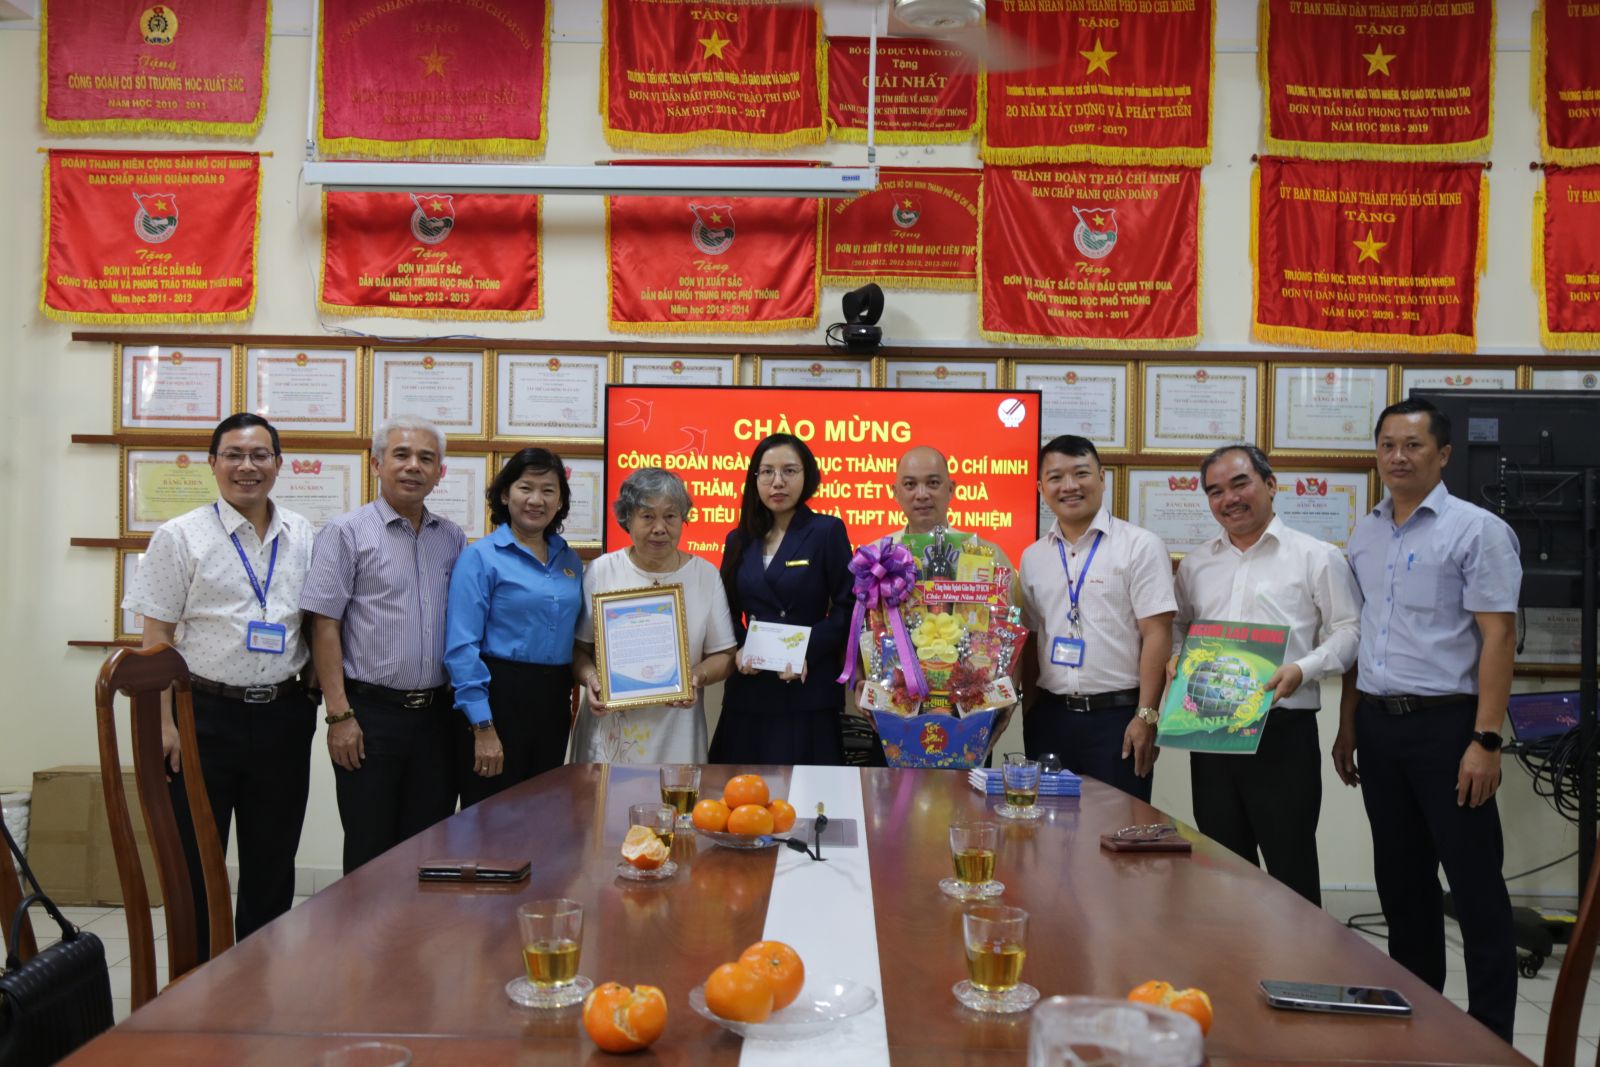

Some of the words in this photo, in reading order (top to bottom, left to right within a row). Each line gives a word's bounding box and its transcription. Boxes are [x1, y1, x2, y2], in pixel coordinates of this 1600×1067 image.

[1079, 17, 1120, 29] TẶNG
[1355, 21, 1406, 37] TẶNG
[893, 59, 918, 69] Tặng
[68, 74, 91, 89] CÔNG
[95, 72, 119, 89] ĐOÀN
[121, 74, 132, 89] CƠ
[135, 70, 148, 90] SỞ
[149, 73, 182, 90] TRƯỜNG
[185, 77, 202, 94] HỌC
[204, 73, 225, 92] XUẤT
[228, 71, 244, 92] SẮC
[902, 72, 948, 88] NHẤT
[1006, 105, 1018, 117] 20
[1021, 102, 1047, 117] NĂM
[1050, 102, 1071, 116] XÂY
[1076, 103, 1105, 118] DỰNG
[1108, 102, 1124, 118] VÀ
[1126, 104, 1155, 119] PHÁT
[1157, 98, 1192, 117] TRIỂN
[1290, 104, 1308, 114] ĐƠN
[1312, 105, 1321, 117] VỊ
[1324, 102, 1342, 115] DẪN
[1345, 103, 1364, 116] ĐẦU
[1368, 106, 1400, 117] PHONG
[1403, 104, 1429, 118] TRÀO
[1431, 107, 1447, 117] THI
[1450, 105, 1471, 115] ĐUA
[1331, 120, 1353, 131] NĂM
[1356, 122, 1377, 133] HỌC
[1380, 123, 1400, 132] 2018
[1408, 123, 1428, 132] 2019
[61, 158, 86, 169] ĐOÀN
[89, 160, 120, 169] THANH
[123, 158, 144, 169] NIÊN
[147, 157, 171, 171] CỘNG
[175, 157, 193, 169] SẢN
[196, 157, 208, 169] HỒ
[212, 158, 226, 169] CHÍ
[229, 159, 252, 169] MINH
[89, 175, 107, 184] BAN
[109, 173, 133, 184] CHẤP
[136, 173, 162, 184] HÀNH
[165, 174, 189, 187] QUẬN
[192, 173, 216, 184] ĐOÀN
[219, 175, 224, 184] 9
[1012, 169, 1051, 182] THÀNH
[1055, 171, 1086, 184] ĐOÀN
[1127, 171, 1148, 184] CHÍ
[1151, 174, 1180, 184] MINH
[1033, 187, 1049, 197] BAN
[1052, 184, 1074, 198] CHẤP
[1077, 186, 1100, 199] HÀNH
[1103, 189, 1126, 201] QUẬN
[1129, 188, 1152, 200] ĐOÀN
[1154, 191, 1158, 199] 9
[1280, 182, 1291, 198] ỦY
[1294, 187, 1311, 199] BAN
[1313, 185, 1336, 202] NHÂN
[1339, 189, 1356, 204] DÂN
[1359, 190, 1388, 205] THÀNH
[1391, 187, 1407, 206] PHỐ
[1410, 188, 1421, 206] HỒ
[1423, 191, 1437, 205] CHÍ
[1439, 192, 1462, 204] MINH
[1568, 185, 1579, 203] ỦY
[1345, 209, 1396, 223] TẶNG
[136, 249, 173, 261] Tặng
[412, 247, 448, 260] Tặng
[104, 265, 120, 276] ĐƠN
[123, 267, 130, 279] VỊ
[132, 265, 150, 276] XUẤT
[154, 265, 168, 276] SẮC
[170, 265, 184, 276] DẪN
[186, 265, 202, 276] ĐẦU
[398, 264, 414, 273] ĐƠN
[416, 265, 423, 276] VỊ
[426, 261, 444, 273] XUẤT
[447, 262, 462, 274] SẮC
[693, 260, 728, 272] Tặng
[1075, 262, 1111, 275] Tặng
[57, 276, 80, 287] CÔNG
[84, 276, 98, 289] TÁC
[99, 277, 118, 289] ĐOÀN
[120, 277, 130, 289] VÀ
[133, 280, 158, 289] PHONG
[161, 277, 180, 288] TRÀO
[182, 279, 207, 288] THANH
[229, 278, 242, 287] NHI
[359, 275, 373, 287] DẪN
[375, 275, 391, 287] ĐẦU
[393, 273, 411, 287] KHỐI
[414, 278, 437, 287] TRUNG
[440, 278, 455, 290] HỌC
[457, 275, 473, 289] PHỔ
[476, 277, 500, 289] THÔNG
[679, 275, 695, 286] ĐƠN
[698, 277, 704, 288] VỊ
[706, 274, 725, 286] XUẤT
[728, 274, 742, 286] SẮC
[112, 294, 130, 303] Năm
[132, 294, 145, 304] học
[148, 294, 168, 303] 2011
[174, 294, 192, 303] 2012
[390, 292, 407, 301] Năm
[410, 293, 422, 303] học
[425, 293, 443, 301] 2012
[451, 293, 469, 302] 2013
[1027, 289, 1046, 302] KHỐI
[1049, 295, 1078, 305] TRUNG
[1080, 296, 1097, 306] HỌC
[1100, 293, 1118, 306] PHỔ
[1121, 294, 1150, 305] THÔNG
[671, 305, 688, 314] Năm
[691, 306, 703, 316] học
[707, 306, 724, 314] 2013
[732, 306, 750, 314] 2014
[1322, 306, 1343, 317] NĂM
[1348, 308, 1368, 319] HỌC
[1373, 310, 1393, 319] 2020
[1402, 311, 1419, 320] 2021
[734, 413, 815, 441] CHÀO
[825, 414, 911, 443] MỪNG
[617, 450, 662, 469] CÔNG
[665, 451, 708, 470] ĐOÀN
[846, 453, 897, 473] THÀNH
[962, 455, 987, 475] CHÍ
[990, 460, 1028, 475] MINH
[692, 478, 737, 499] THĂM,
[855, 481, 883, 499] TẾT
[955, 482, 988, 500] QUÀ
[702, 504, 735, 523] TIỂU
[846, 510, 884, 525] THPT
[965, 510, 1012, 531] NHIỆM
[687, 541, 719, 552] Thành
